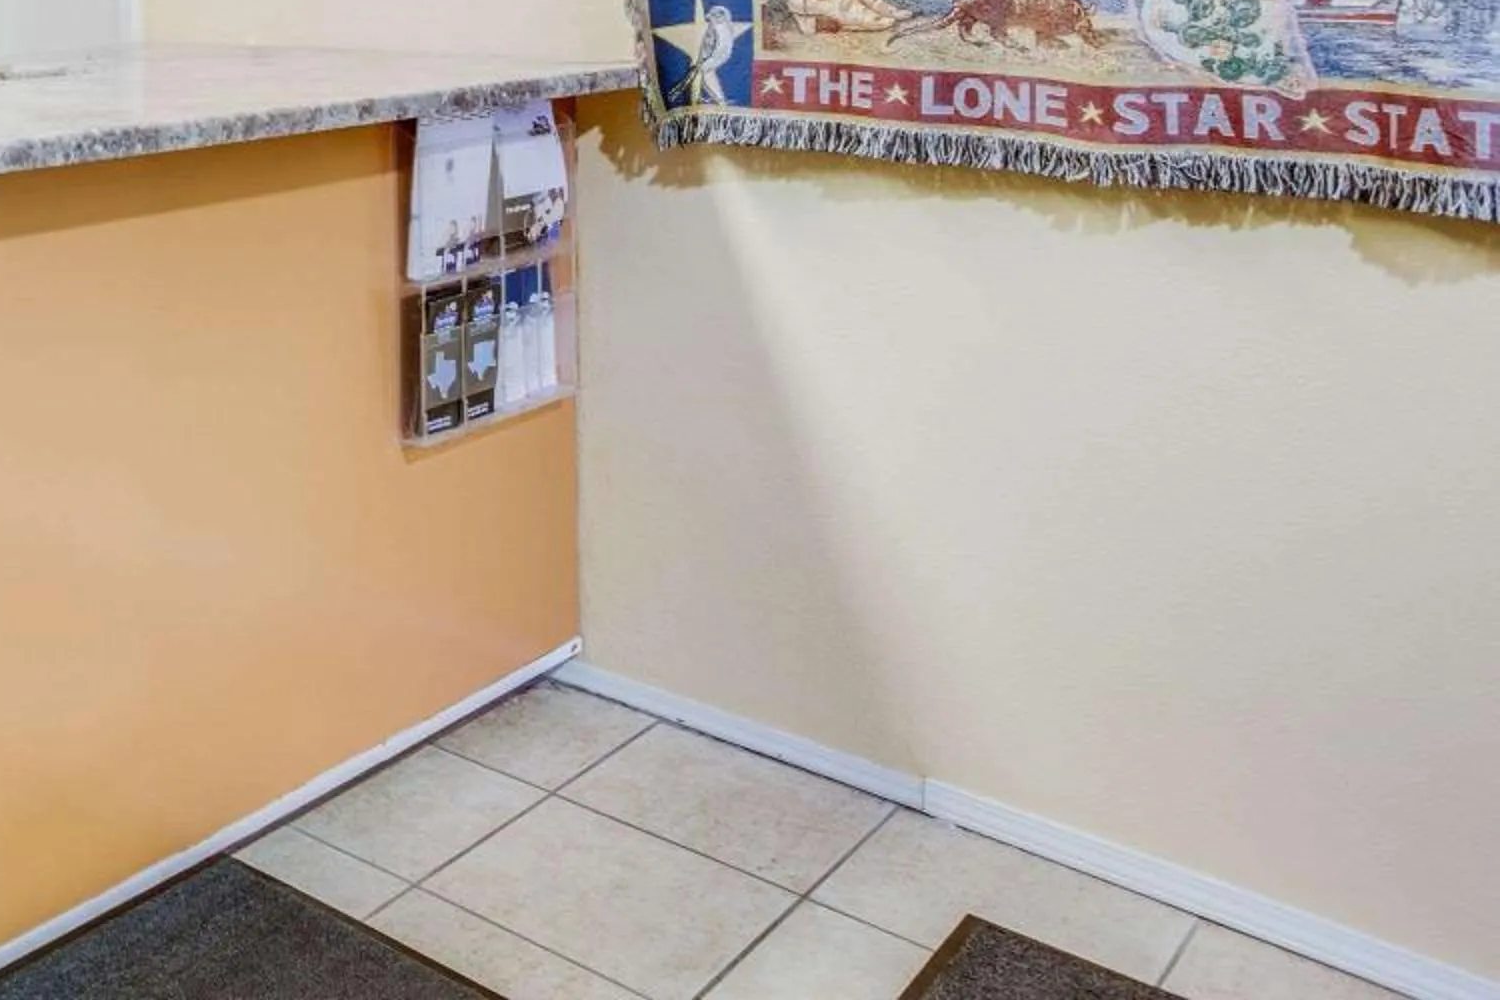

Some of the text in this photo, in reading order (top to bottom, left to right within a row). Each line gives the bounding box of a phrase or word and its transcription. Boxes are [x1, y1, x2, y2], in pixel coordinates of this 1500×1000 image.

[783, 68, 874, 109] THE
[920, 75, 1069, 128] LONE
[1111, 93, 1286, 141] STAR
